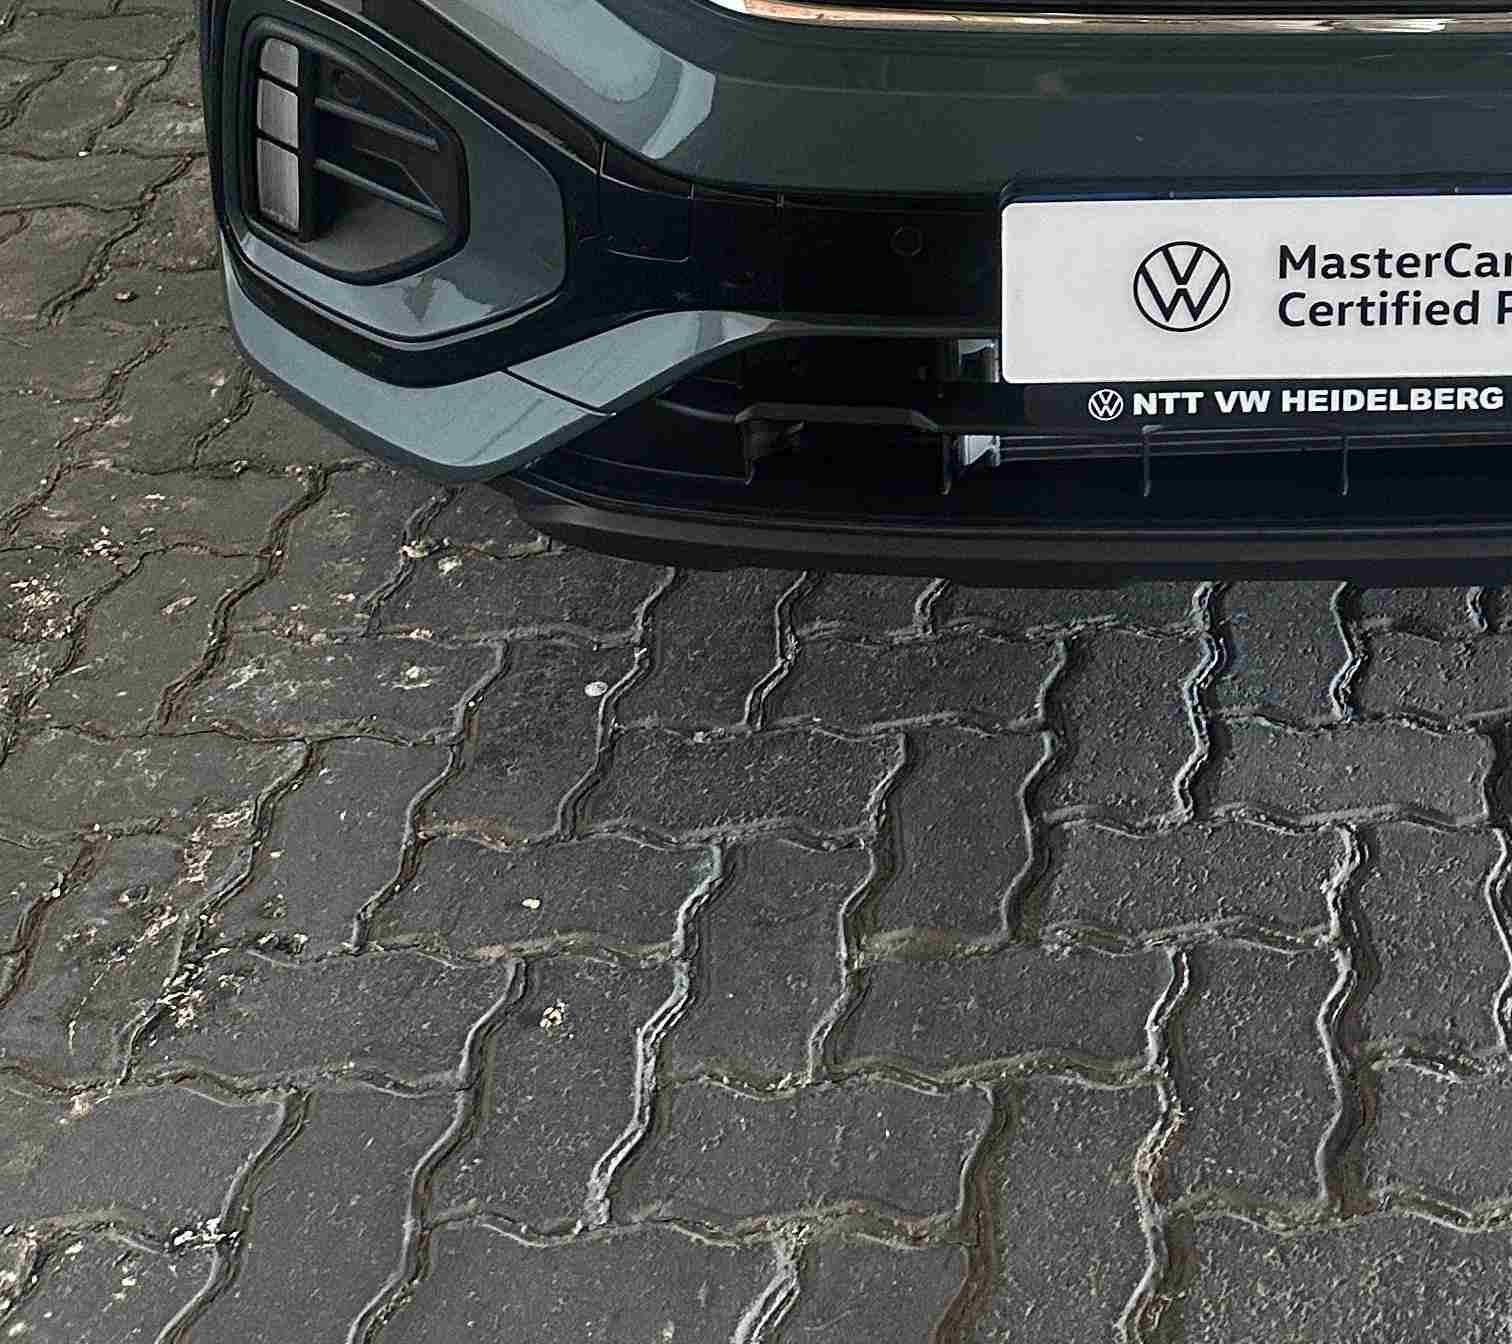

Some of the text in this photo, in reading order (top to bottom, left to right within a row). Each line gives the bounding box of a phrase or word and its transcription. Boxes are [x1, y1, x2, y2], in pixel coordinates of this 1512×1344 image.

[1278, 289, 1480, 328] Certified
[1133, 391, 1204, 416] NTT
[1214, 390, 1271, 413] VW
[1282, 387, 1504, 413] HEIDELBERG
